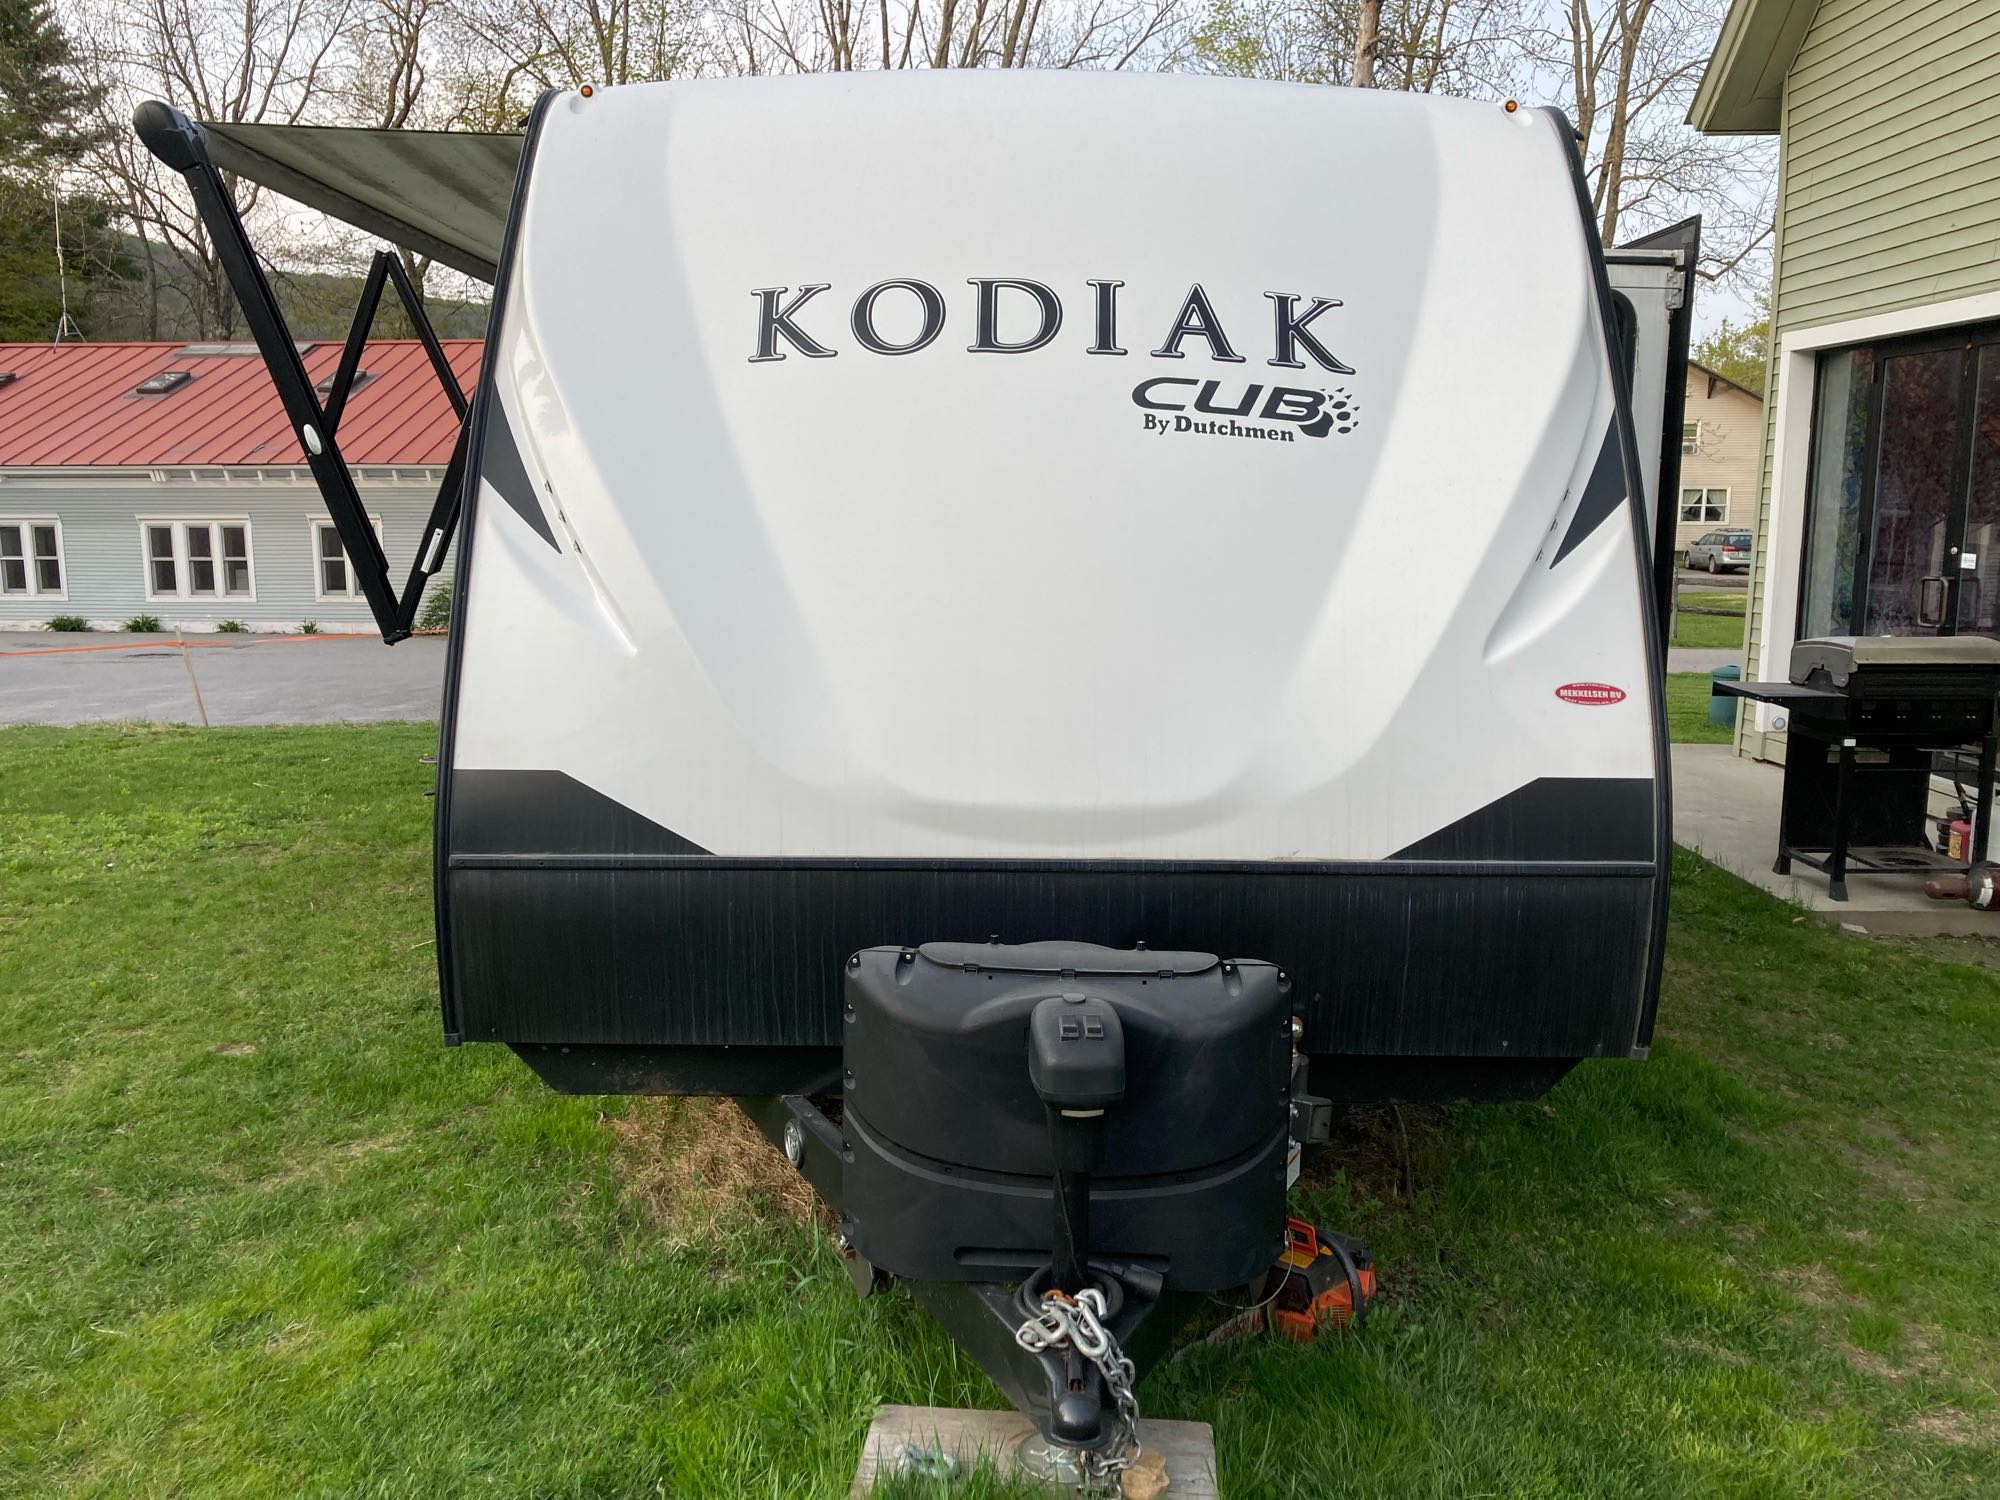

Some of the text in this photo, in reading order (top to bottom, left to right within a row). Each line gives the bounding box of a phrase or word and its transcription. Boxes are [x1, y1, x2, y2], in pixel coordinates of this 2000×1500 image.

[748, 278, 1356, 375] KODIAK
[1131, 376, 1327, 423] CUB
[1143, 413, 1295, 442] By Dutchmen
[1560, 689, 1622, 699] MEKKELSEN RV
